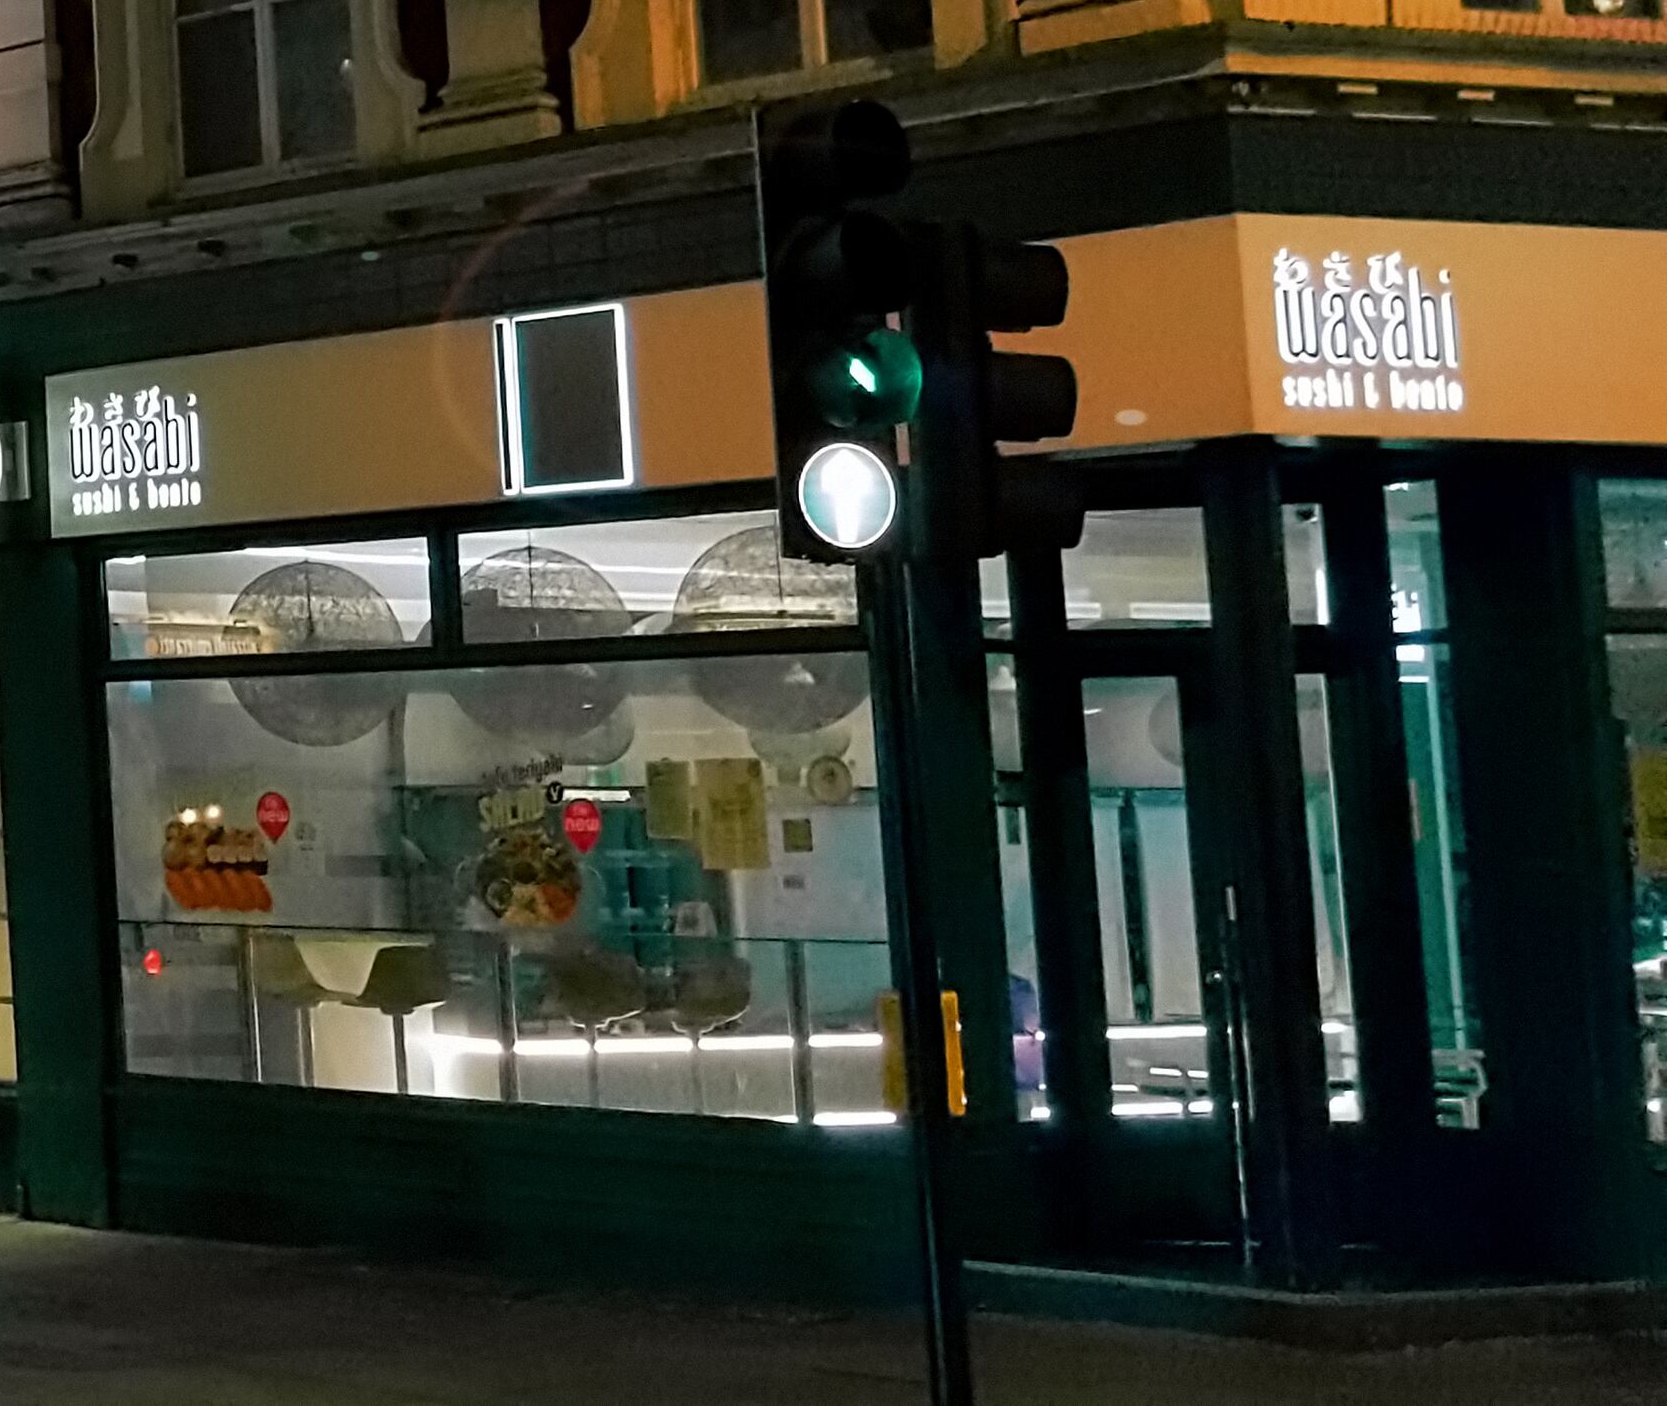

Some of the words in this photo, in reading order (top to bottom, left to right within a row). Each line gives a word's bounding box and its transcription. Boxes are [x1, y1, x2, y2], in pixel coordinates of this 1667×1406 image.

[1274, 267, 1459, 368] wasabi
[1282, 368, 1355, 408] sushi
[1389, 370, 1464, 412] bento
[69, 393, 200, 483] wasabi
[72, 483, 122, 516] sushi
[147, 478, 202, 510] bento
